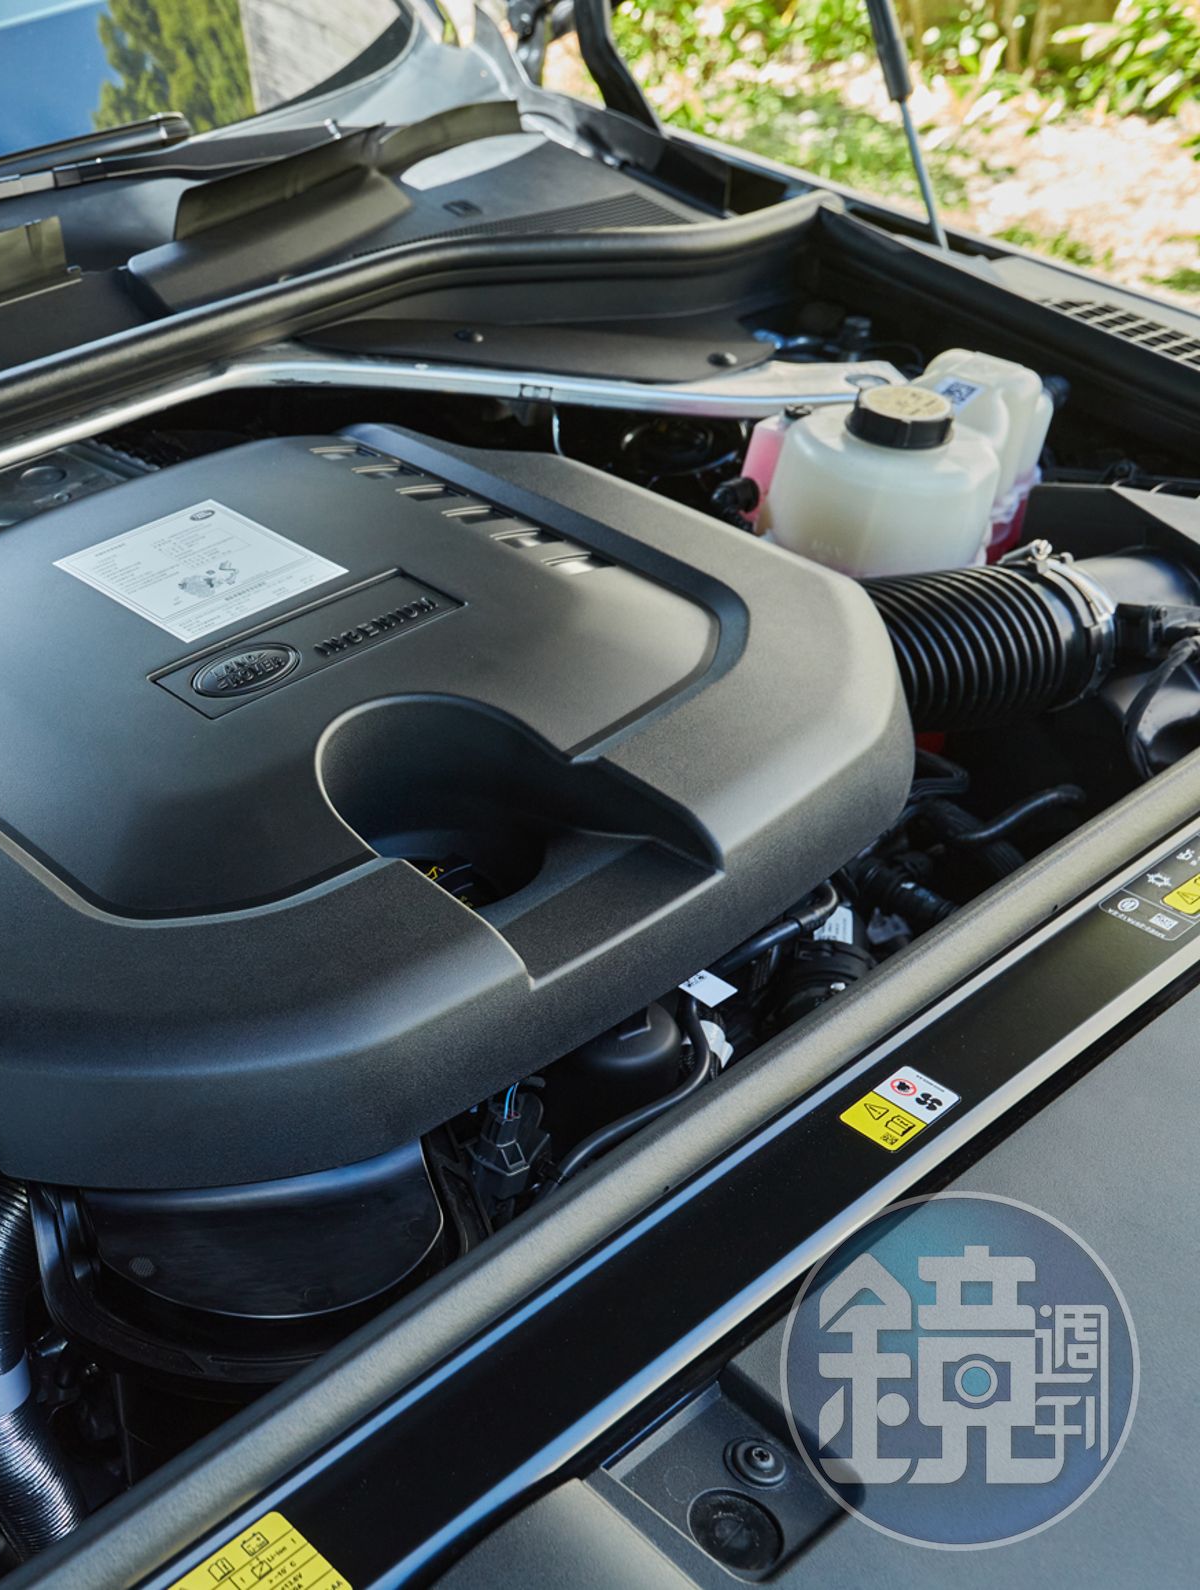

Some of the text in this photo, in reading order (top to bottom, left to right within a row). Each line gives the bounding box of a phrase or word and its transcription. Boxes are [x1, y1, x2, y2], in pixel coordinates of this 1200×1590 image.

[313, 597, 439, 657] INGENIUM
[210, 655, 260, 679] LAND
[226, 656, 286, 688] ROVER
